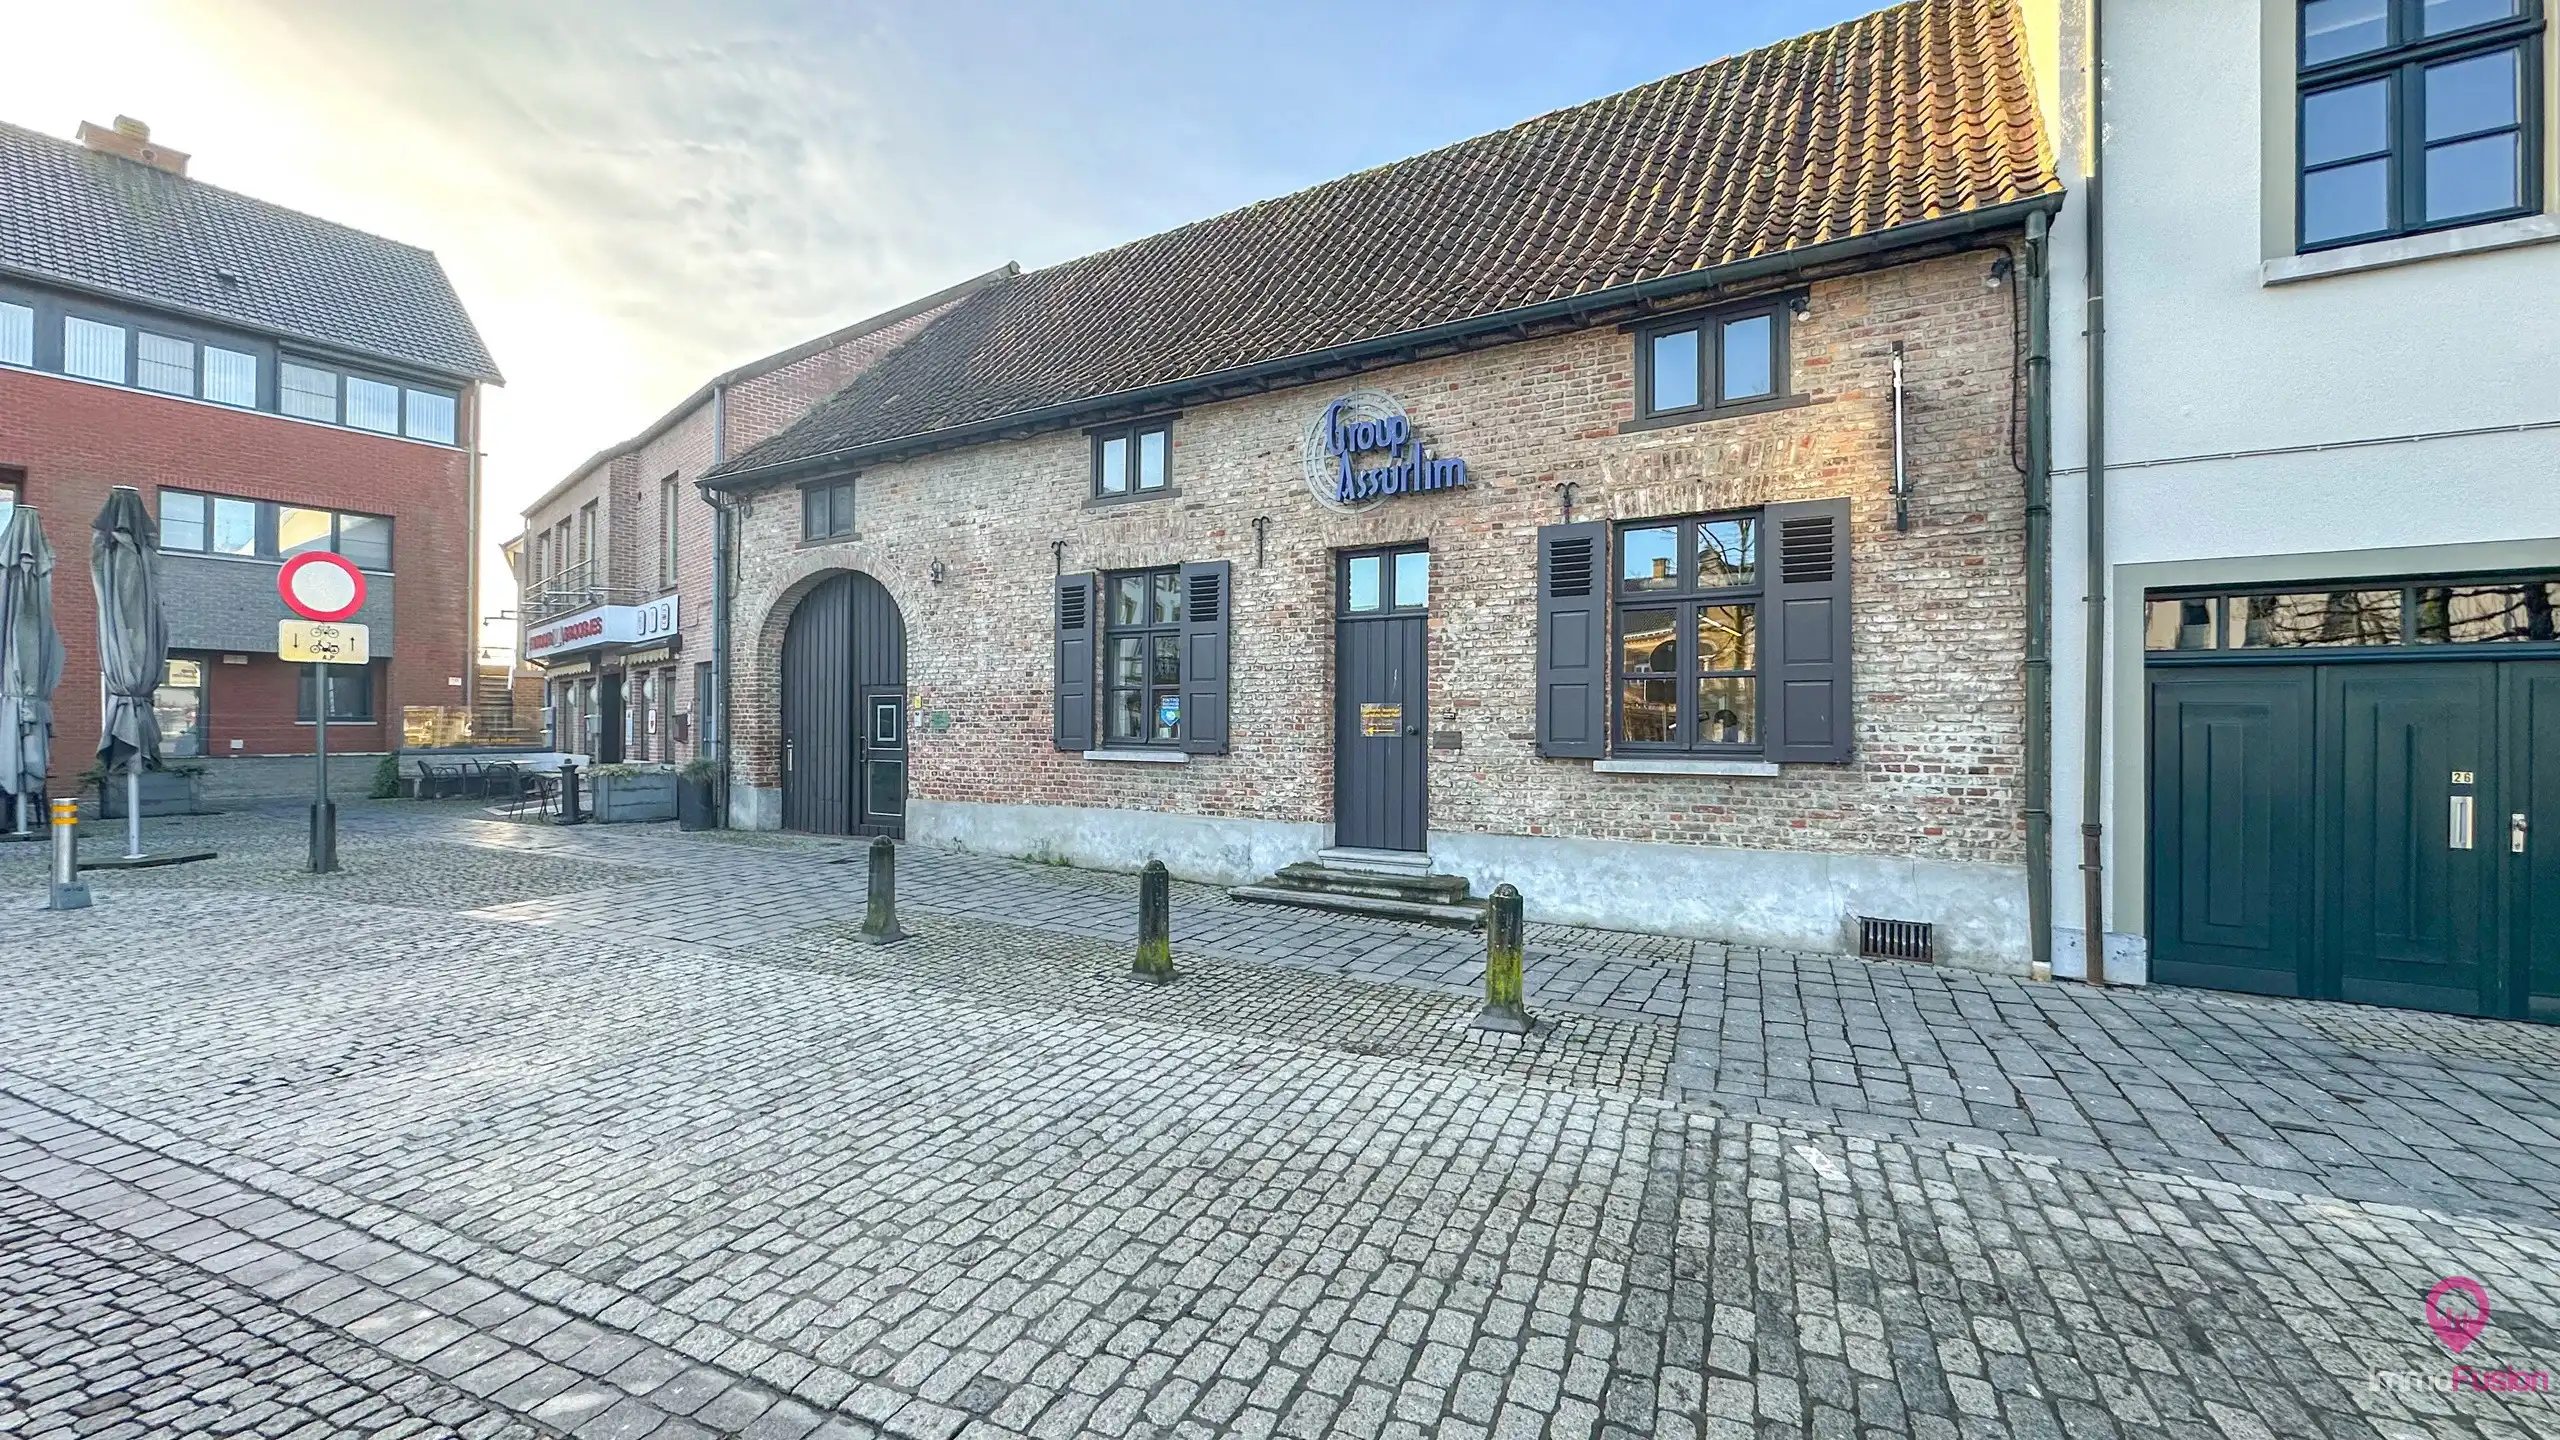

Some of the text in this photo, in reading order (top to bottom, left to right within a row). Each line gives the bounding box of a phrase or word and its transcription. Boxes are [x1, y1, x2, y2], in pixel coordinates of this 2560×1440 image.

[1326, 400, 1409, 457] Group
[1336, 441, 1467, 502] Assurlim
[2453, 772, 2471, 782] 26
